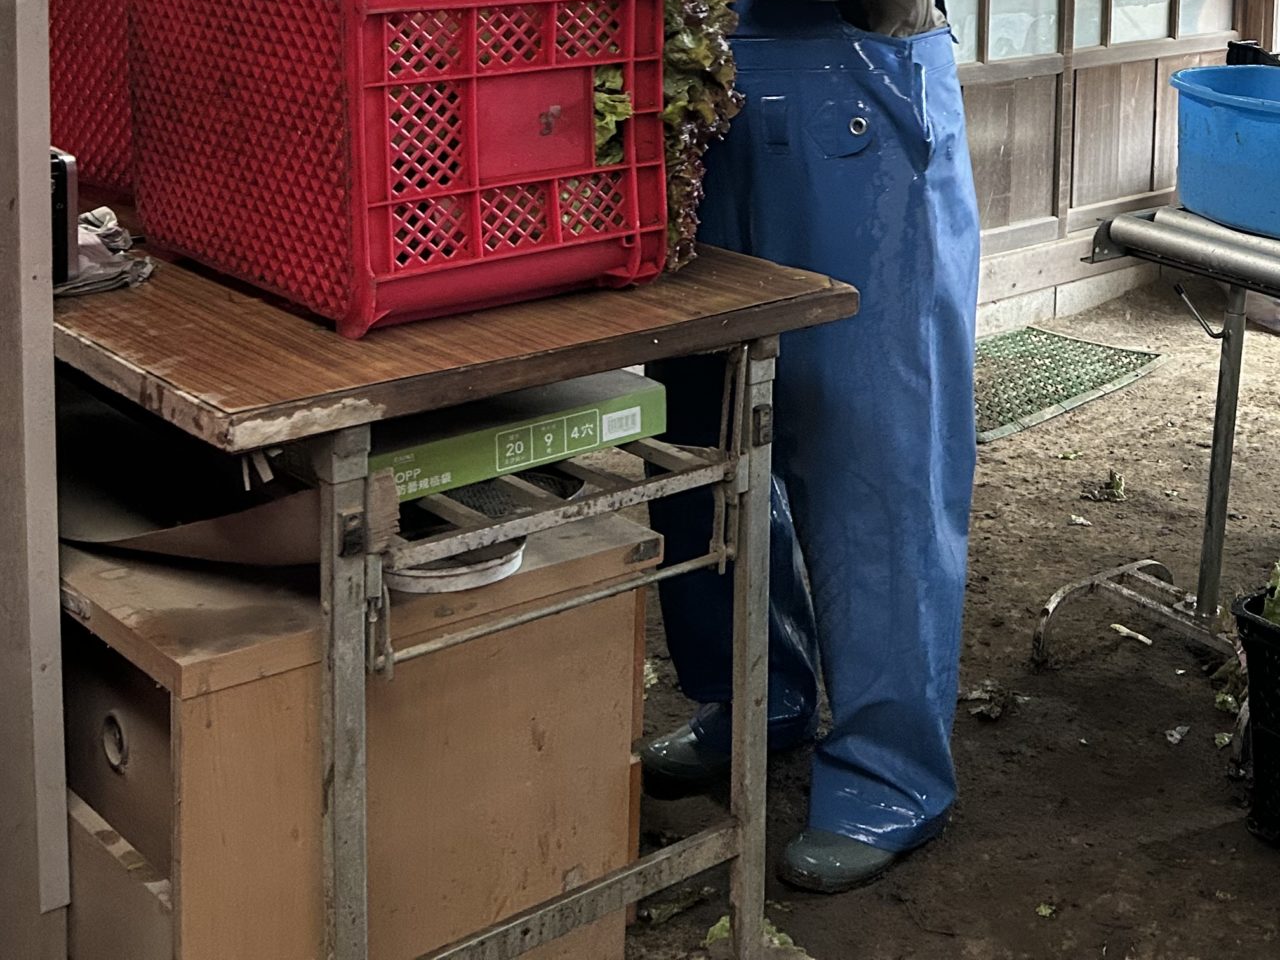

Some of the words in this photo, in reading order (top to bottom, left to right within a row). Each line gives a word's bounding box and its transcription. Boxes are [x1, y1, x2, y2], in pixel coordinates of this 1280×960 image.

[570, 423, 594, 439] 4穴
[544, 433, 553, 446] 9
[505, 441, 524, 457] 20
[395, 468, 422, 484] OPP
